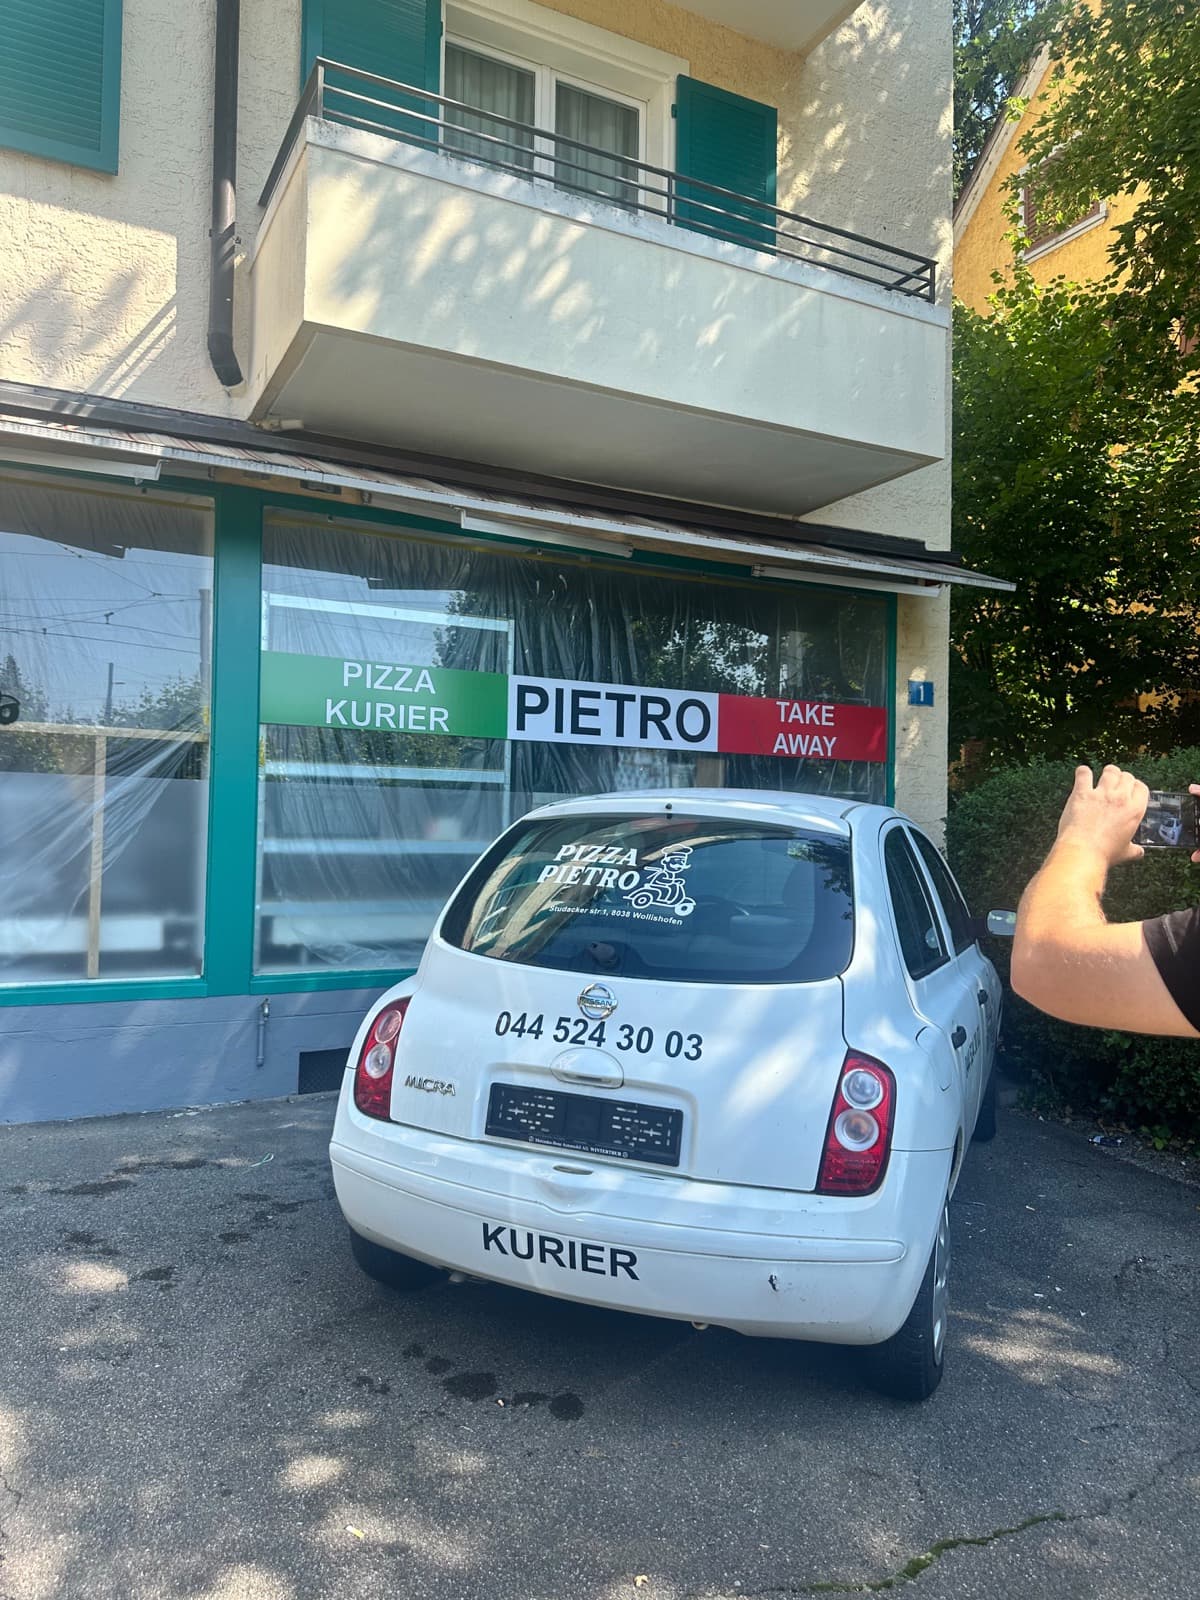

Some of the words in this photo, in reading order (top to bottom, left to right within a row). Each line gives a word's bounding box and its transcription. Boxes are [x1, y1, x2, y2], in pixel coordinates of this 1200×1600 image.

[342, 661, 436, 695] PIZZA
[919, 684, 925, 702] 1
[325, 699, 449, 733] KURIER
[515, 684, 712, 743] PIETRO
[775, 701, 836, 728] TAKE
[772, 736, 837, 758] AWAY
[553, 844, 638, 867] PIZZA
[537, 864, 641, 891] PIETRO
[611, 910, 630, 919] 8038
[495, 1011, 544, 1040] 044
[552, 1016, 606, 1048] 524
[616, 1023, 654, 1054] 30
[665, 1030, 704, 1061] 03
[404, 1074, 456, 1097] MICRA
[482, 1222, 640, 1281] KURIER
